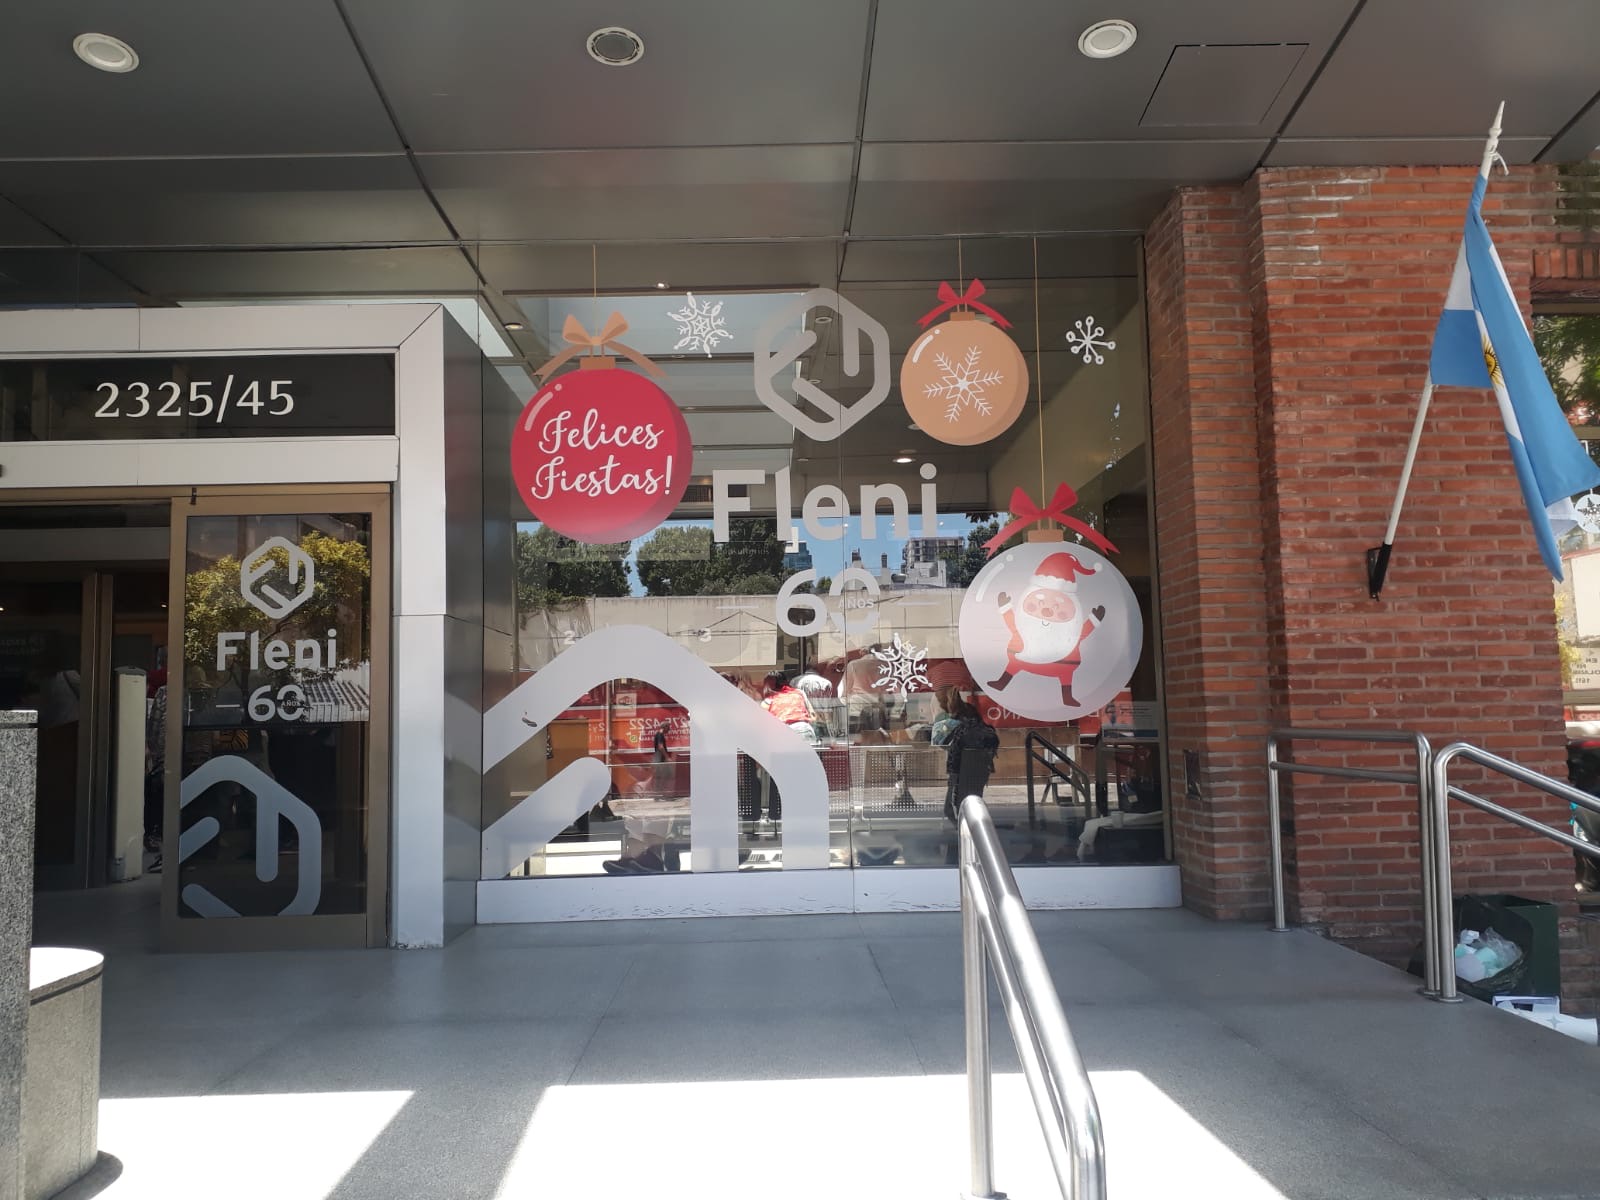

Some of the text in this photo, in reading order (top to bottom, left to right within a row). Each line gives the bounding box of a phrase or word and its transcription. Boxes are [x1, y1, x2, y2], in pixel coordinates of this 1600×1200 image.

[94, 374, 294, 423] 2325/45
[538, 408, 664, 454] Felices
[531, 454, 673, 500] Fiestas!
[712, 463, 938, 543] Fleni
[776, 568, 881, 637] 60
[216, 629, 337, 671] Fleni
[248, 684, 306, 722] 60
